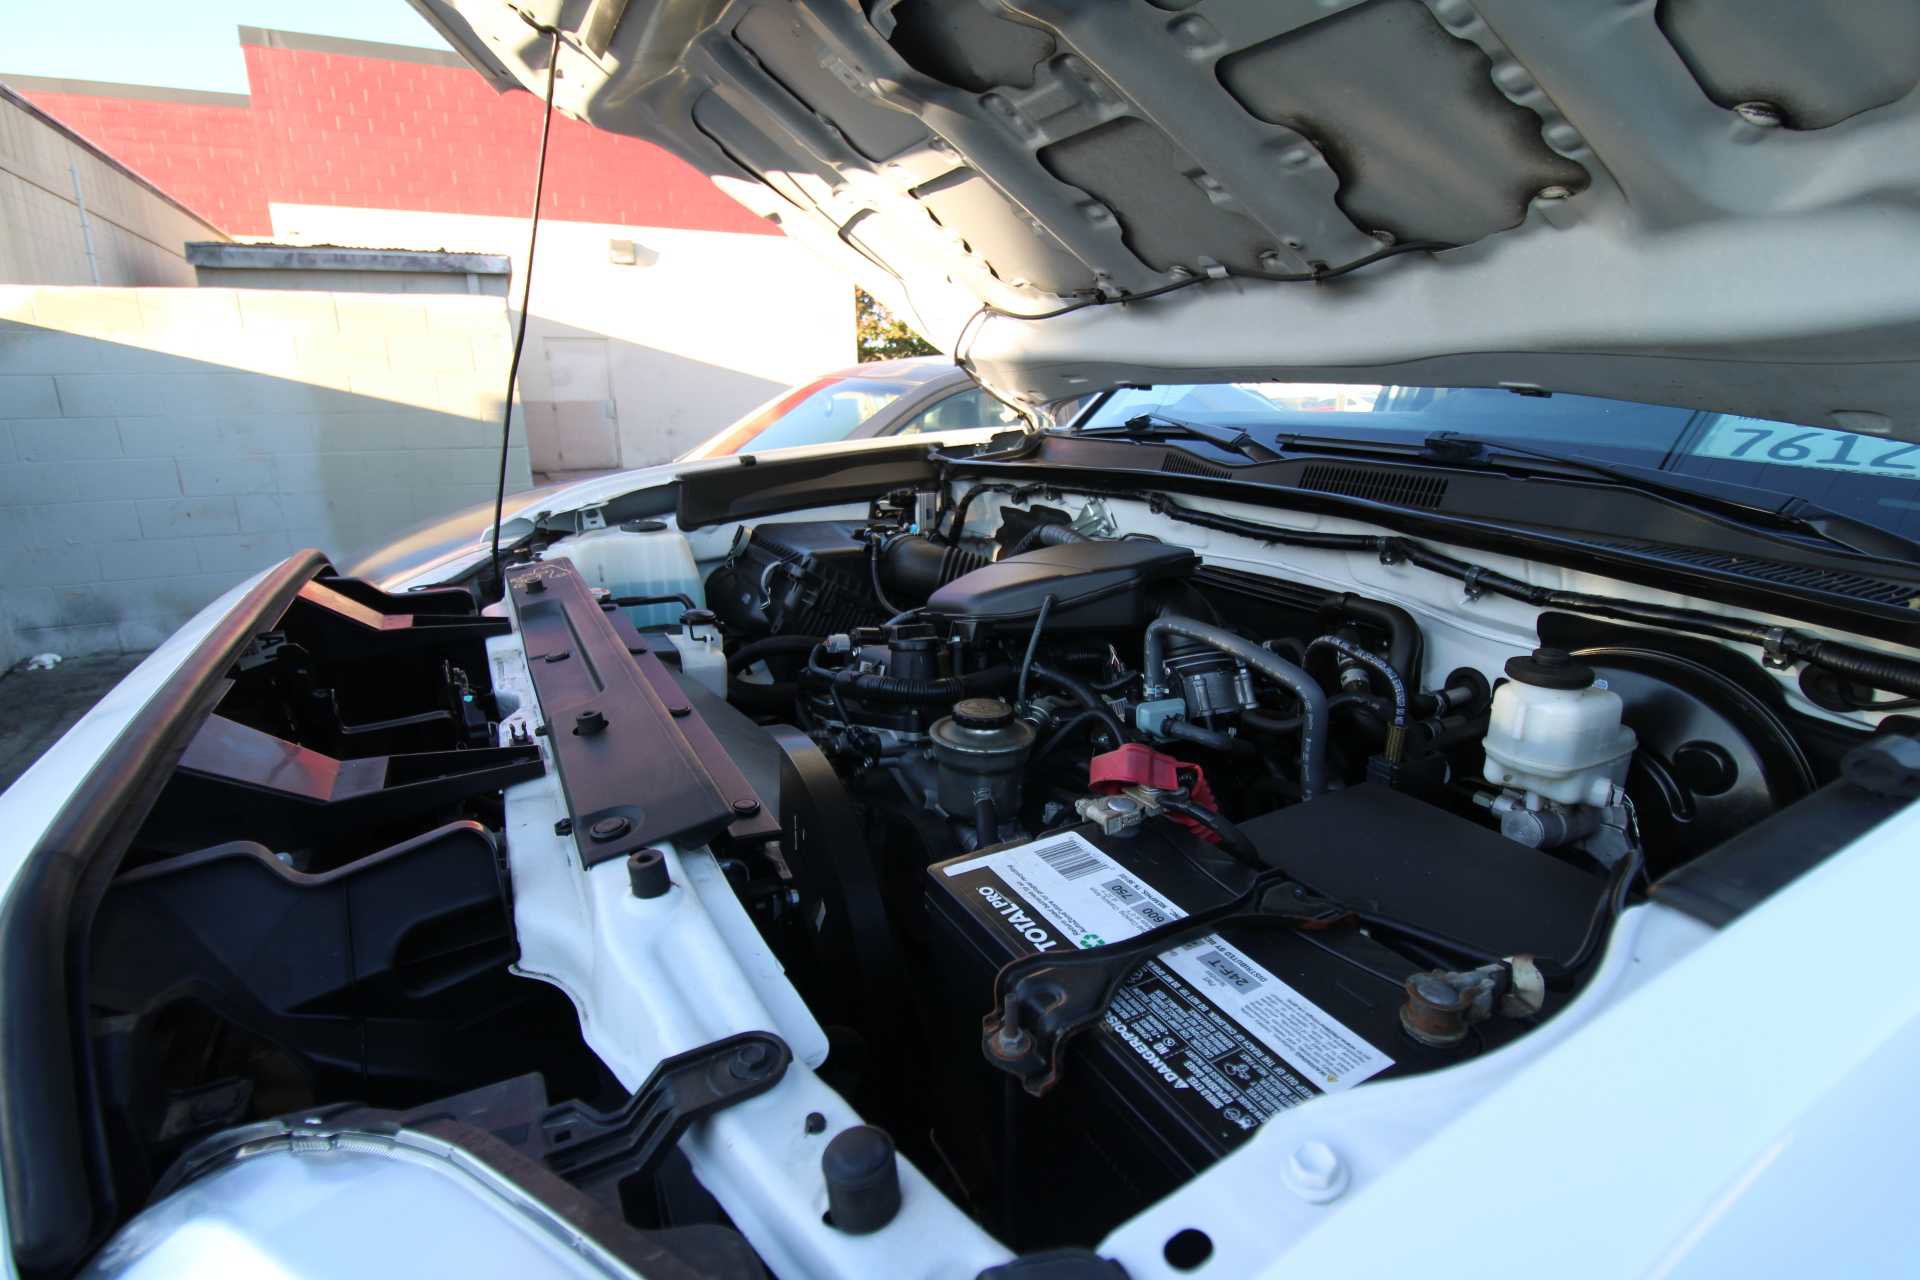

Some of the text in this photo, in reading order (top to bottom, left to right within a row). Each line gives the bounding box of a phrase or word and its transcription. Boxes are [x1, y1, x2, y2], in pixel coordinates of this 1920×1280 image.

[1111, 885, 1133, 899] 750
[979, 886, 1057, 952] TOTALPRO
[1142, 907, 1165, 923] 600
[1207, 959, 1249, 986] 24F-T
[1102, 1010, 1177, 1083] DANGER/POIS
